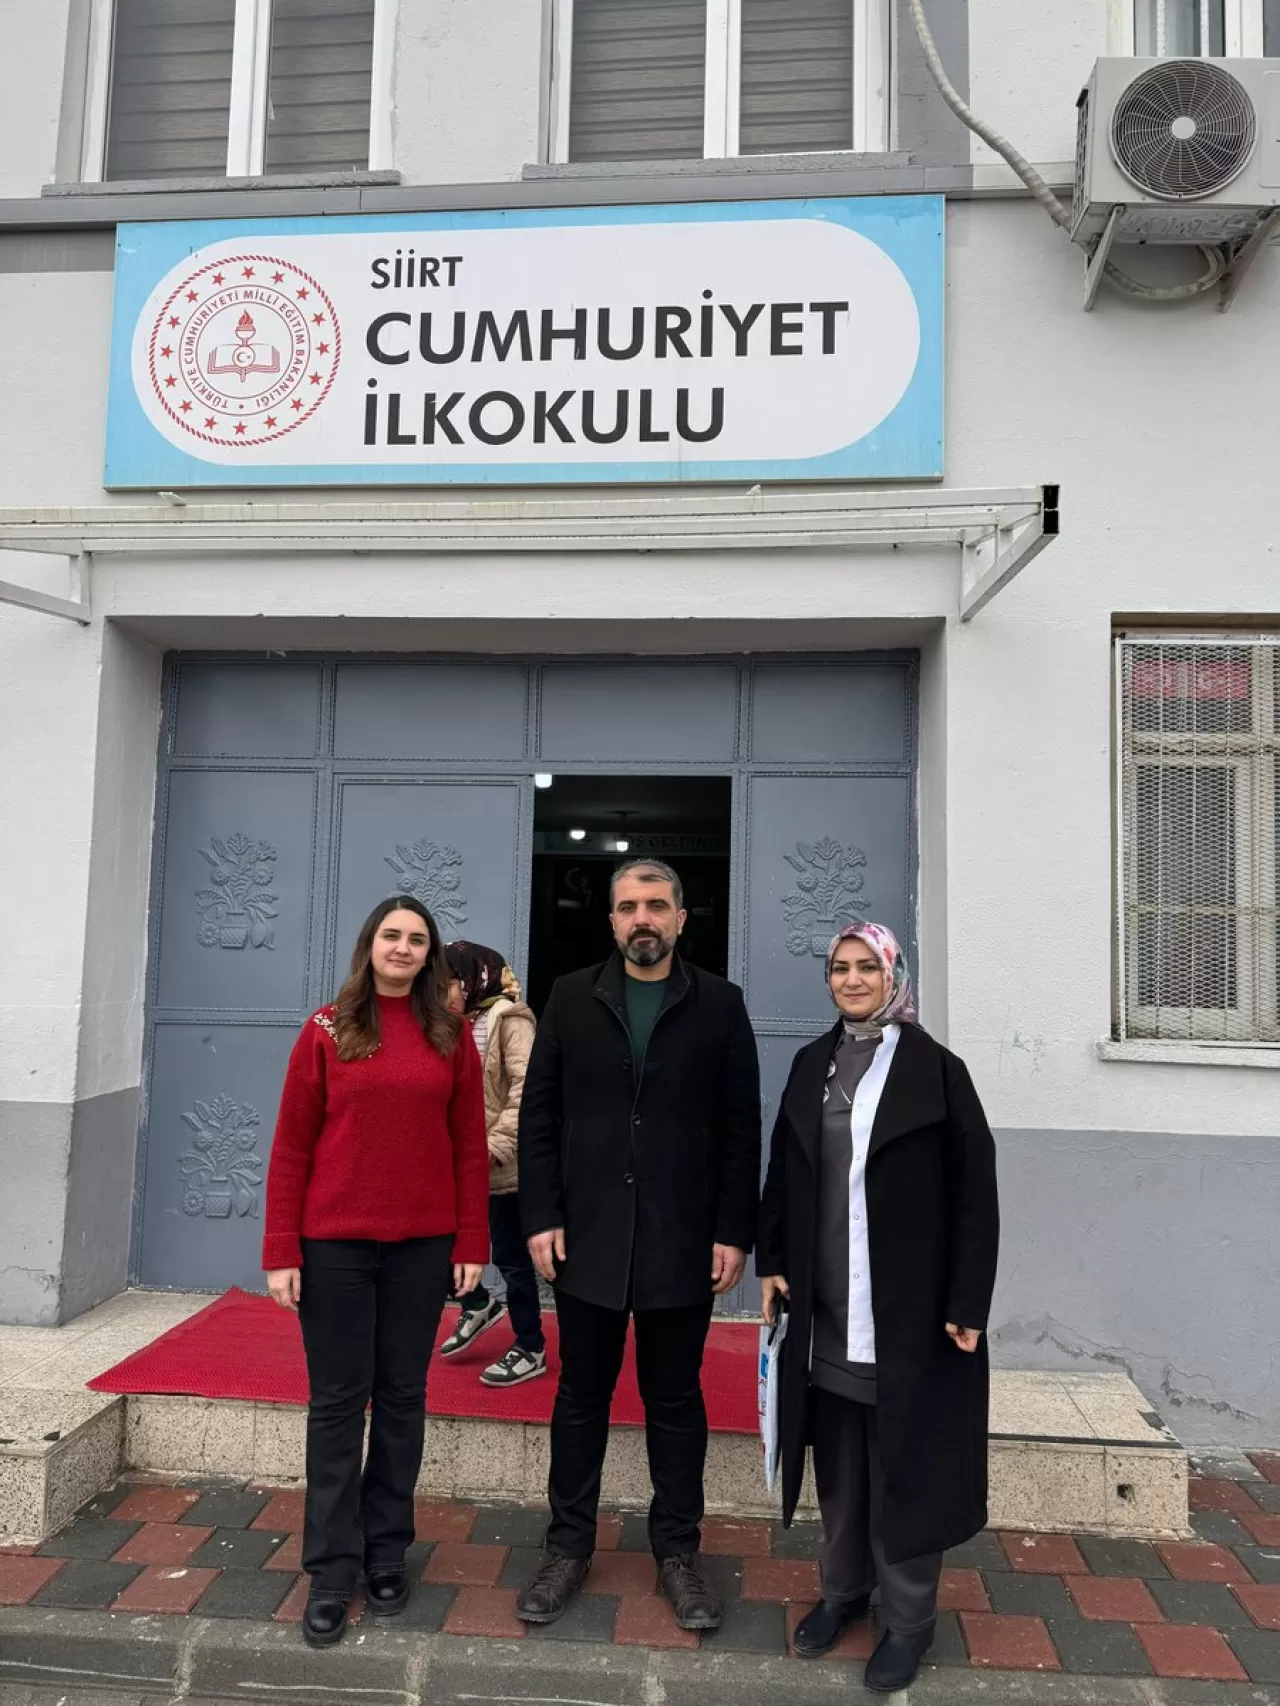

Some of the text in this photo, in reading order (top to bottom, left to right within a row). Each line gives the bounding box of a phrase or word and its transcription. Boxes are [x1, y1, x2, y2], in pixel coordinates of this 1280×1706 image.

[371, 249, 462, 288] SİİRT
[185, 290, 239, 364] CUMHURİYETİ
[280, 303, 305, 345] EĞİTİM
[366, 289, 849, 365] CUMHURİYET
[188, 369, 228, 408] TÜRKİYE
[257, 350, 305, 408] BAKANLIĞI
[365, 378, 724, 446] İLKOKULU
